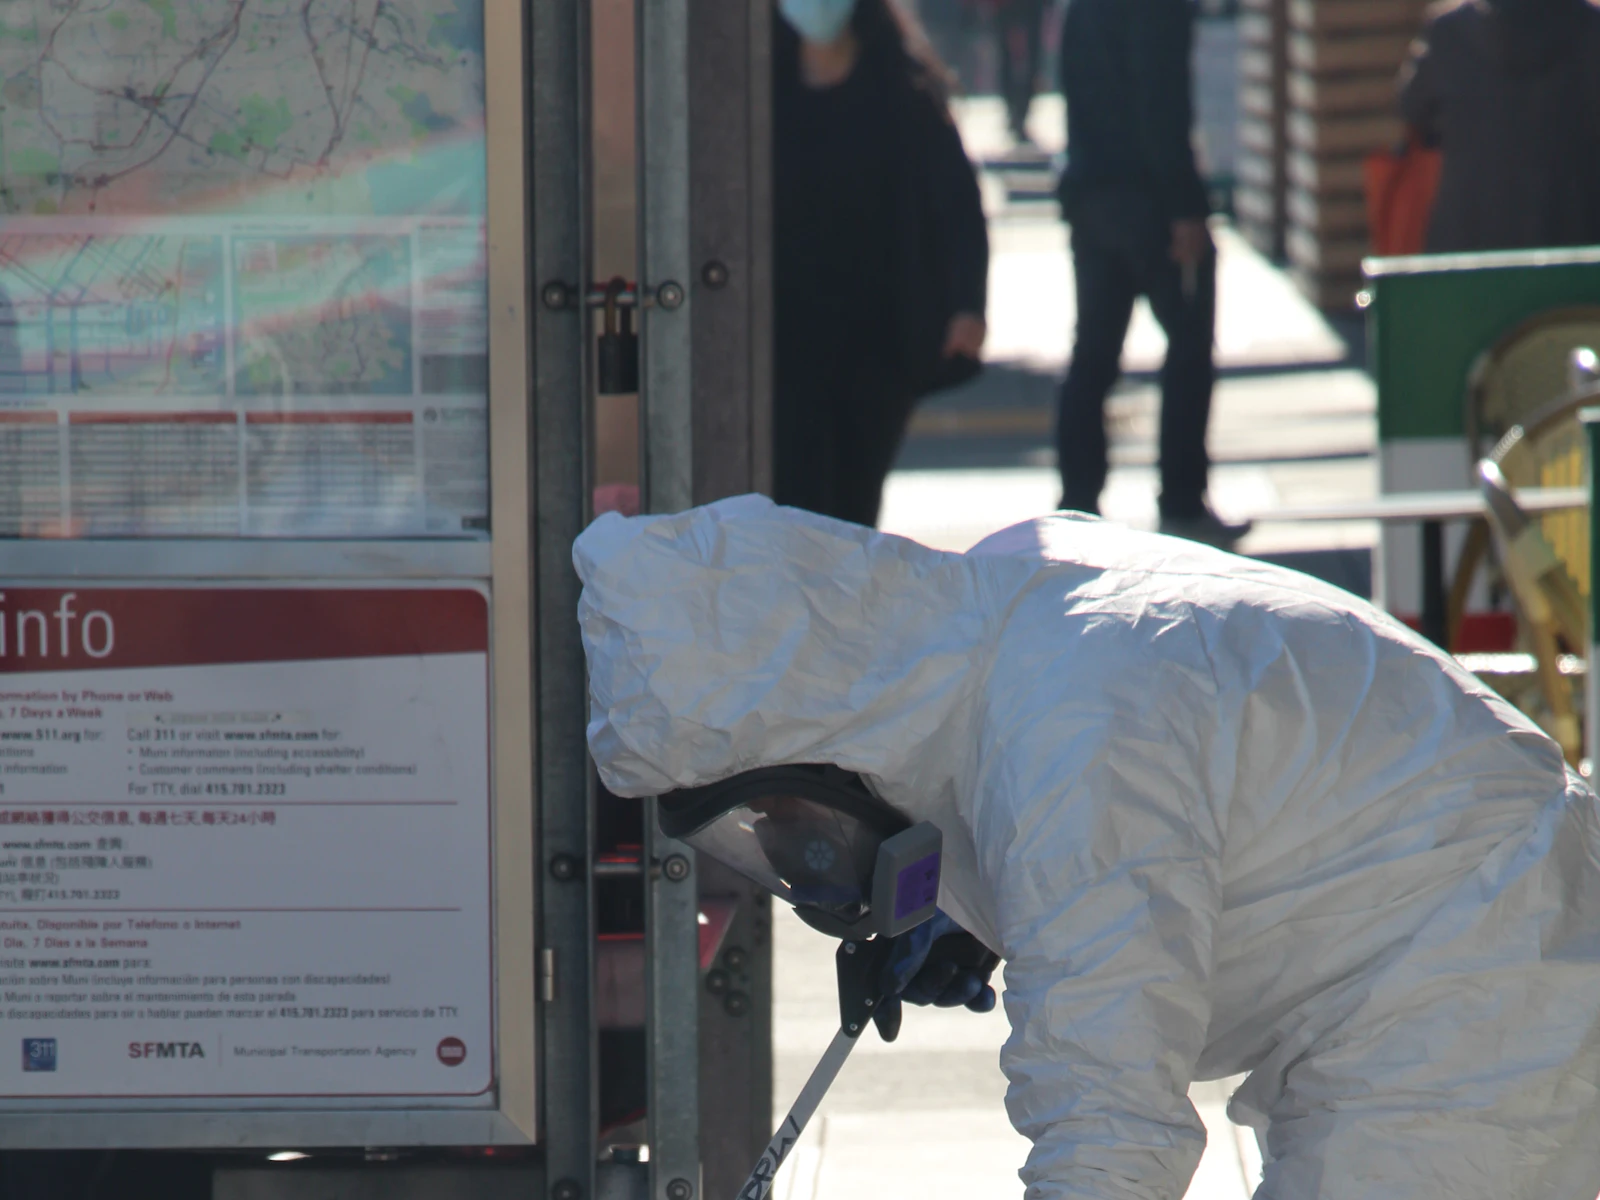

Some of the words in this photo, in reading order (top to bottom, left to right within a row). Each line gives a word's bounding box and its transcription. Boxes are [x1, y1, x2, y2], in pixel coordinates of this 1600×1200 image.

[0, 592, 115, 658] info
[62, 690, 77, 704] by
[82, 689, 124, 702] Phone
[128, 692, 141, 702] or
[144, 689, 174, 702] Web
[10, 706, 17, 718] 7
[20, 706, 52, 720] Days
[57, 710, 64, 719] a
[67, 706, 103, 719] Week
[1, 728, 81, 743] www.511.org
[127, 728, 150, 741] Call
[154, 728, 175, 741] 311
[178, 731, 192, 741] or
[195, 728, 220, 741] visit
[223, 729, 319, 741] www.sfmta.com
[139, 746, 167, 758] Muni
[292, 744, 365, 761] accessibility)
[4, 762, 68, 775] information
[139, 763, 193, 775] Customer
[195, 763, 254, 775] comments
[314, 761, 352, 774] shelter
[355, 761, 417, 776] conditions)
[128, 782, 148, 795] For
[180, 782, 202, 795] dial
[206, 782, 286, 796] 415.701.2323
[2, 838, 91, 850] www.sfmta.com
[37, 919, 99, 933] Disponible
[102, 921, 122, 933] por
[182, 921, 191, 931] o
[194, 918, 242, 931] Internet
[74, 939, 82, 949] a
[85, 936, 96, 949] la
[100, 937, 149, 949] Semana
[29, 957, 121, 970] www.sfmta.com
[28, 974, 59, 986] sobre
[61, 974, 89, 986] Muni
[202, 975, 227, 988] para
[229, 975, 279, 988] personas
[282, 975, 301, 986] con
[4, 991, 32, 1003] Muni
[91, 991, 121, 1003] sobre
[135, 991, 215, 1003] mantenimiento
[217, 990, 231, 1003] de
[233, 991, 256, 1003] esta
[258, 990, 296, 1004] parada
[7, 1008, 92, 1022] discapacidades
[94, 1009, 119, 1022] para
[147, 1008, 181, 1020] hablar
[183, 1007, 224, 1022] pueden
[227, 1008, 265, 1019] marcar
[268, 1006, 278, 1018] el
[280, 1006, 349, 1018] 415.701.2323
[351, 1008, 376, 1021] para
[378, 1005, 420, 1018] servicio
[422, 1005, 436, 1018] de
[30, 1040, 55, 1058] 311
[128, 1041, 205, 1060] SFMTA
[233, 1044, 287, 1059] Municipal
[290, 1044, 371, 1059] Transportation
[374, 1044, 417, 1060] Agency
